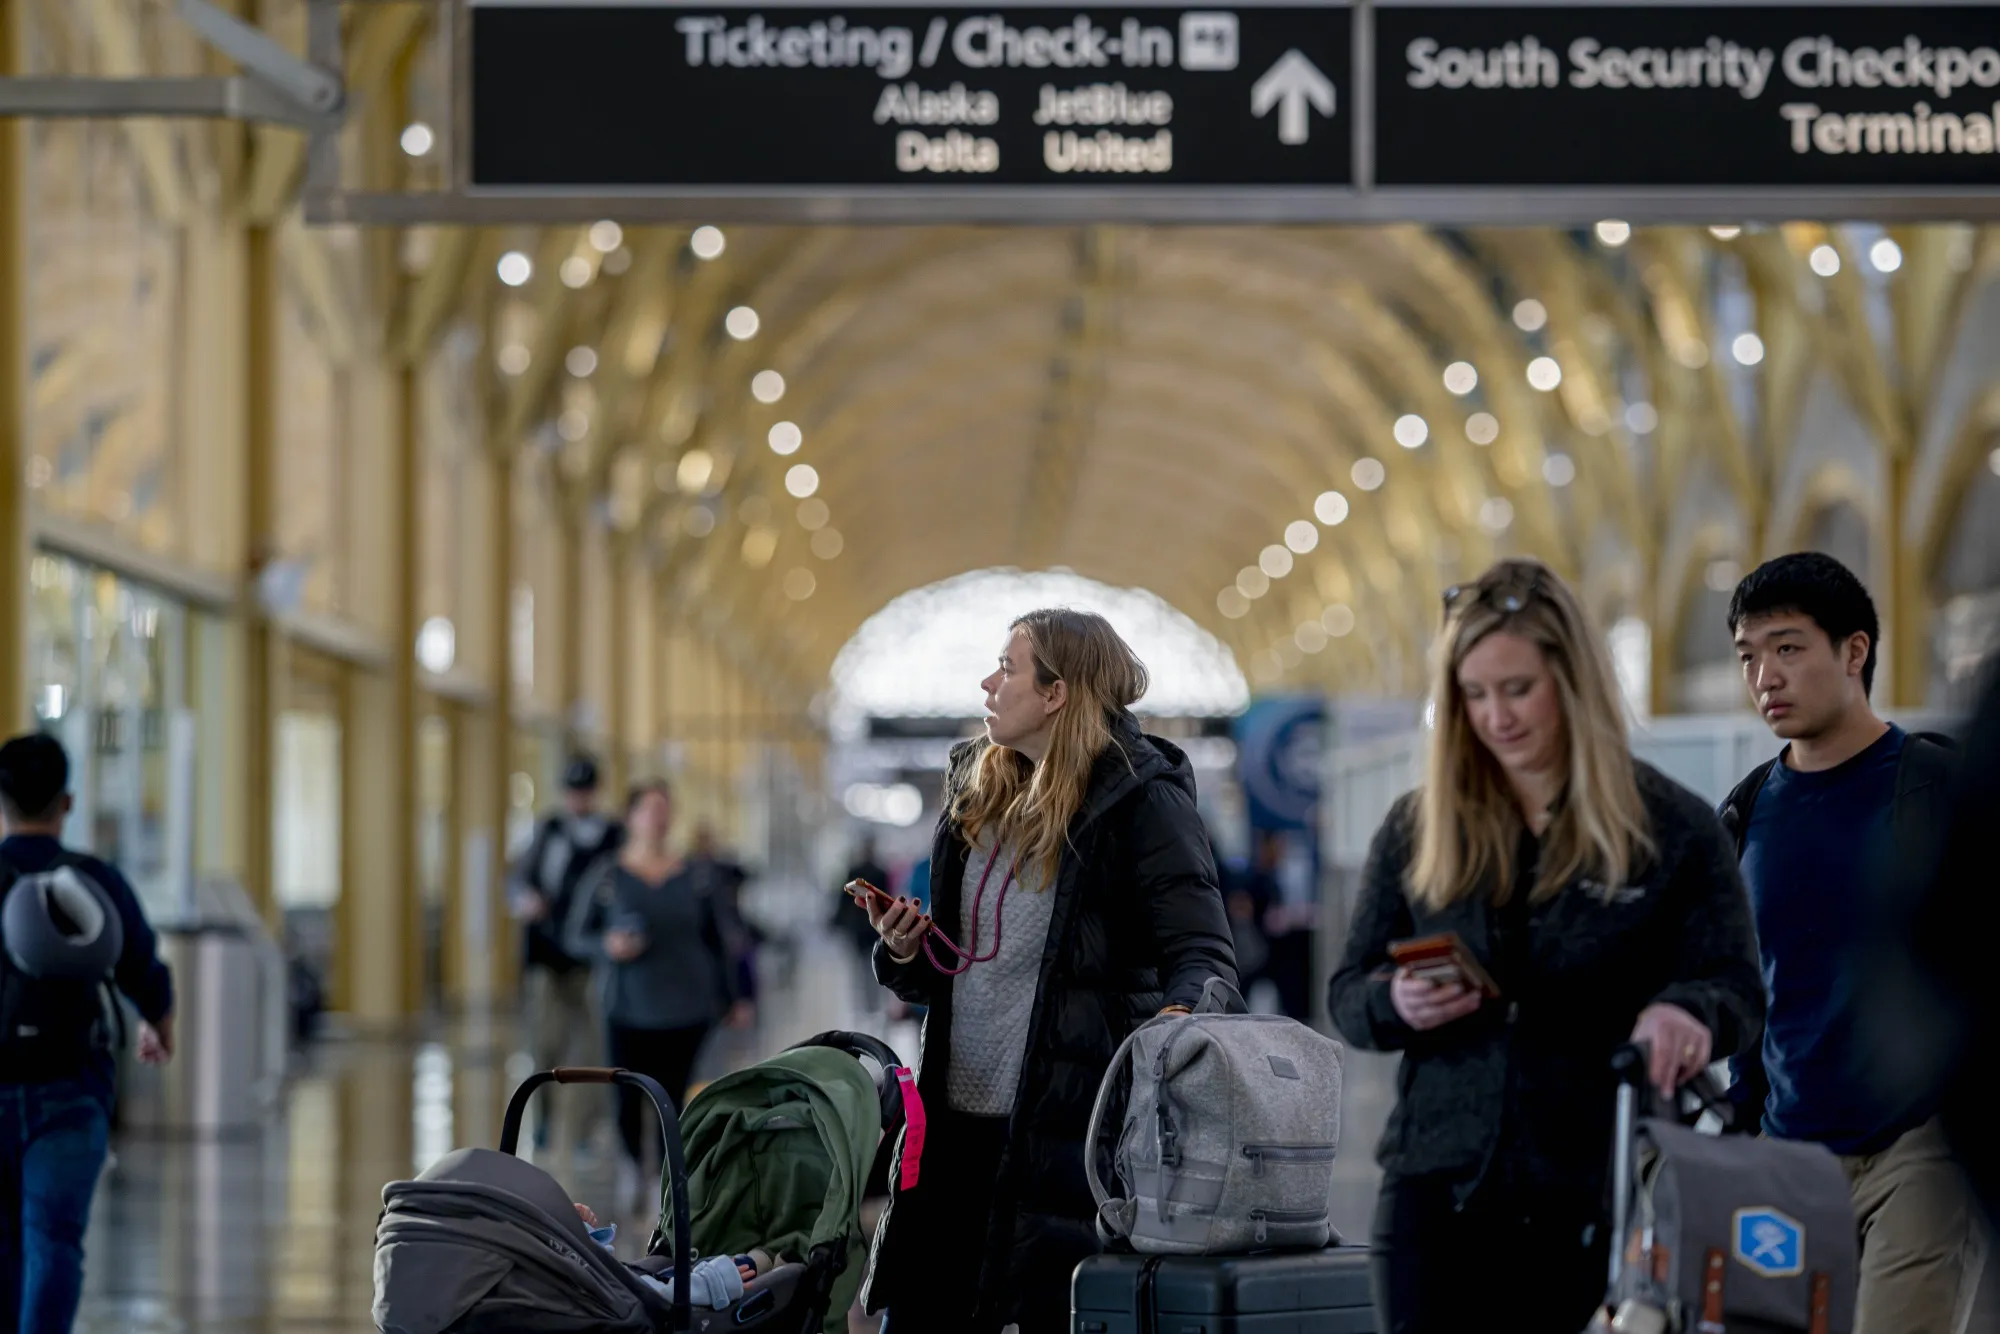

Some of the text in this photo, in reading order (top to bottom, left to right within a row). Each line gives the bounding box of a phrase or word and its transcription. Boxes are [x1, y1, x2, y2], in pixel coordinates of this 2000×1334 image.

[676, 14, 1173, 78] Ticketing / Check-In
[1407, 36, 2000, 97] South Security Checkpo
[874, 82, 999, 125] Alaska
[1033, 82, 1173, 125] JetBlue
[896, 130, 999, 172] Delta
[1044, 129, 1173, 172] United
